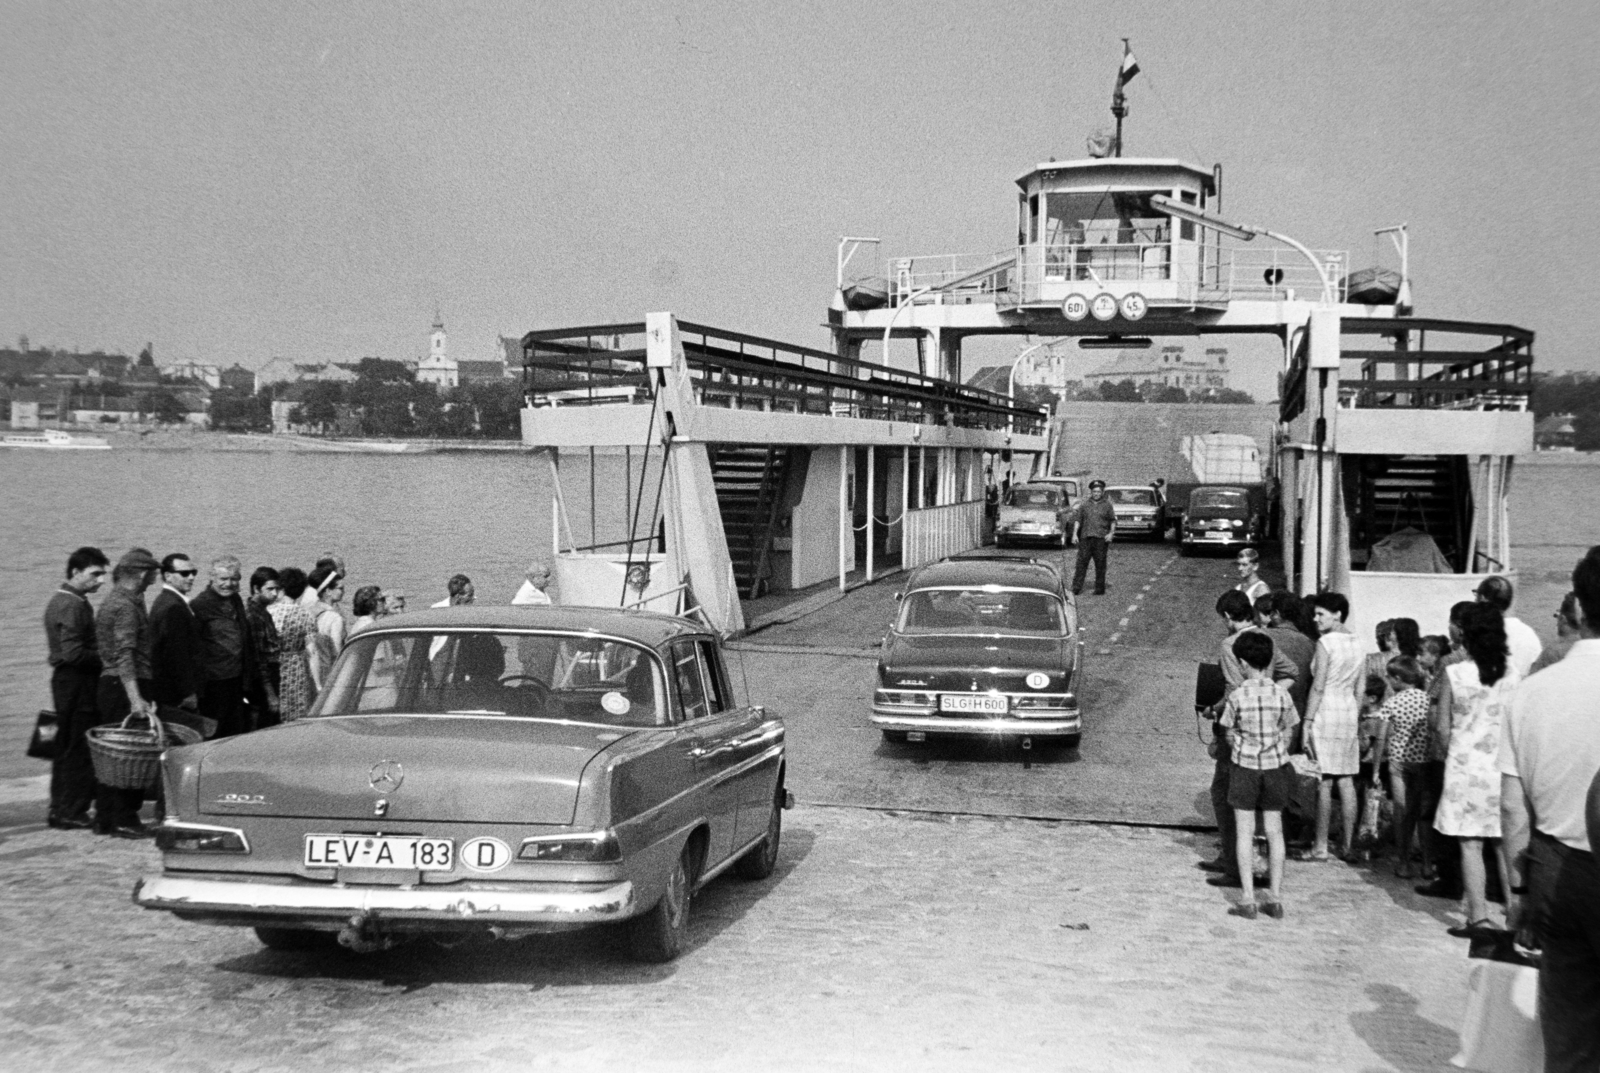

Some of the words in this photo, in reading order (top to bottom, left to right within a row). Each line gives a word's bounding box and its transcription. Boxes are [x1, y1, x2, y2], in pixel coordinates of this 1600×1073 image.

[1033, 675, 1043, 686] D
[984, 699, 1005, 710] 600
[410, 841, 450, 865] 183
[477, 842, 496, 867] D
